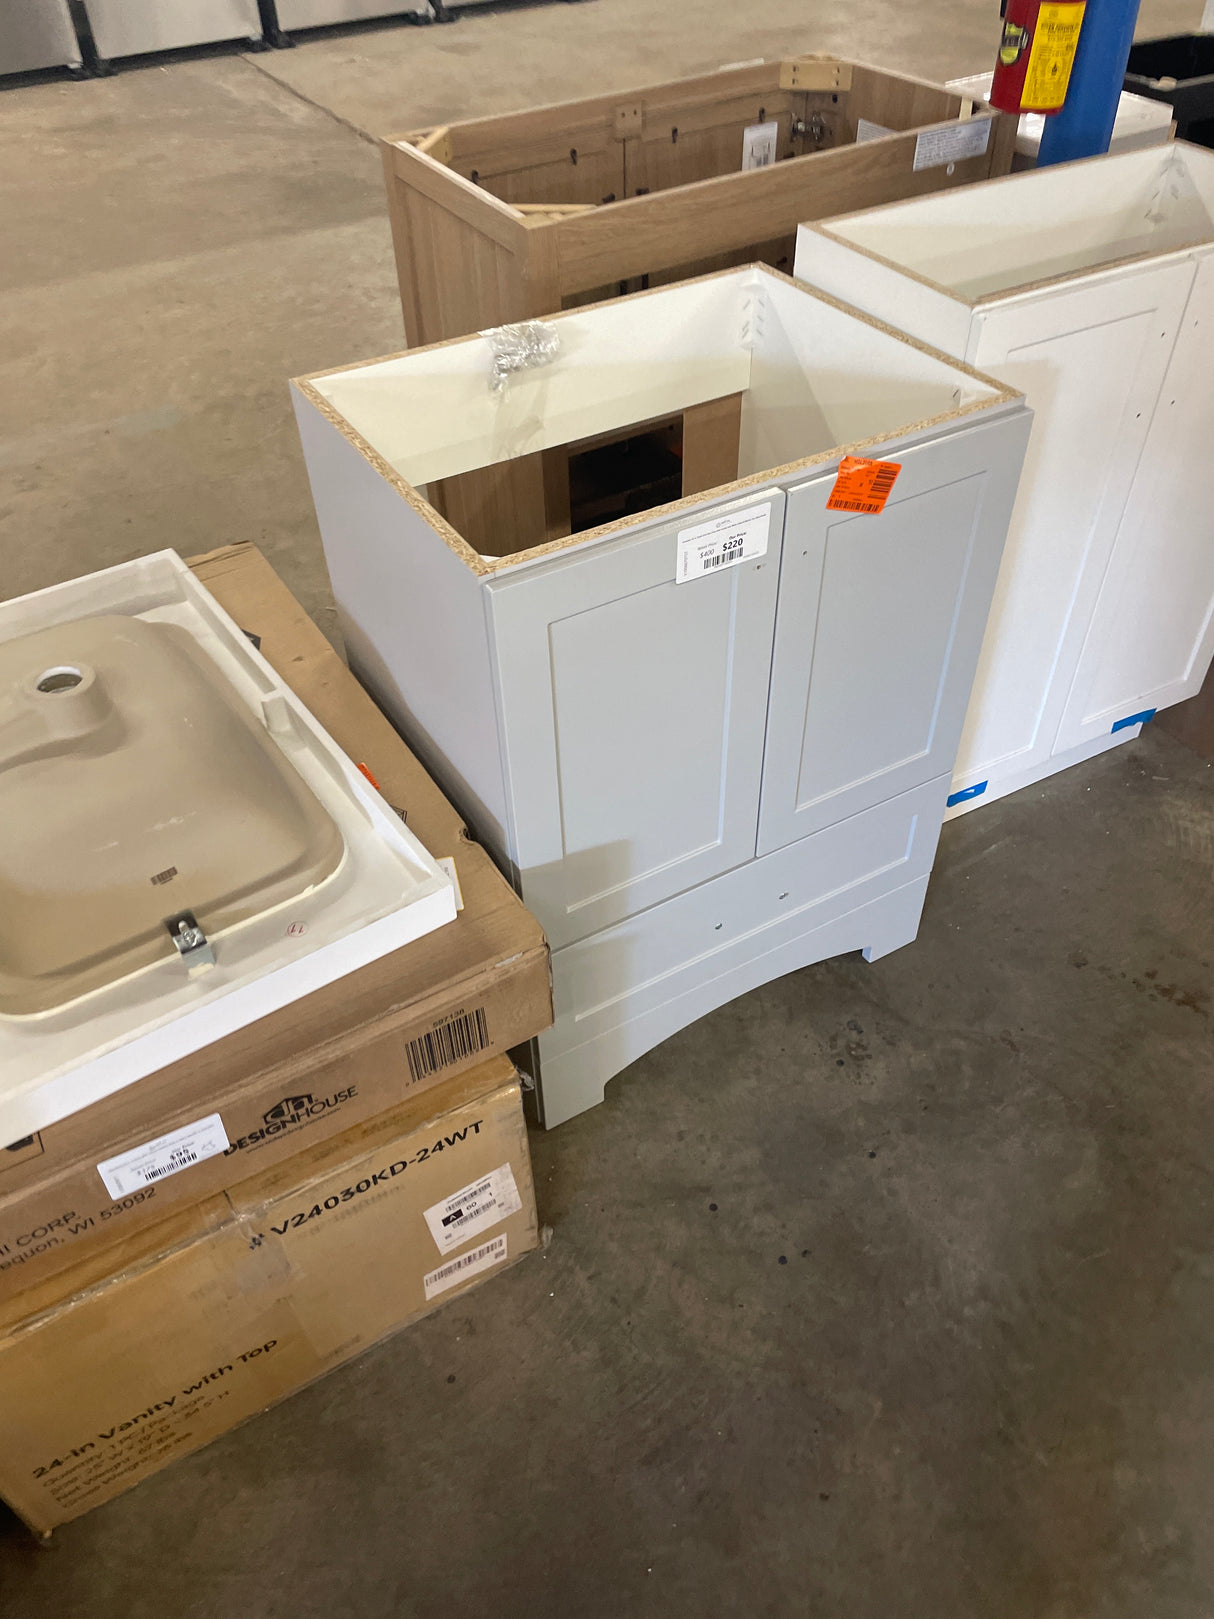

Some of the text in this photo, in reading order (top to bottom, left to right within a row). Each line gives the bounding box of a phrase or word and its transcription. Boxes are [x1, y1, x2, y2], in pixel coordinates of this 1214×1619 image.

[699, 548, 715, 559] $400
[722, 536, 744, 553] $220
[223, 1085, 360, 1157] DESIGNHOUSE
[269, 1120, 485, 1237] V24030KD-24WT
[16, 1210, 80, 1247] CORP.
[68, 1217, 96, 1236] WI
[100, 1186, 157, 1221] 53092
[97, 1395, 178, 1440] Vanity
[182, 1362, 234, 1396] with
[237, 1338, 279, 1364] Top
